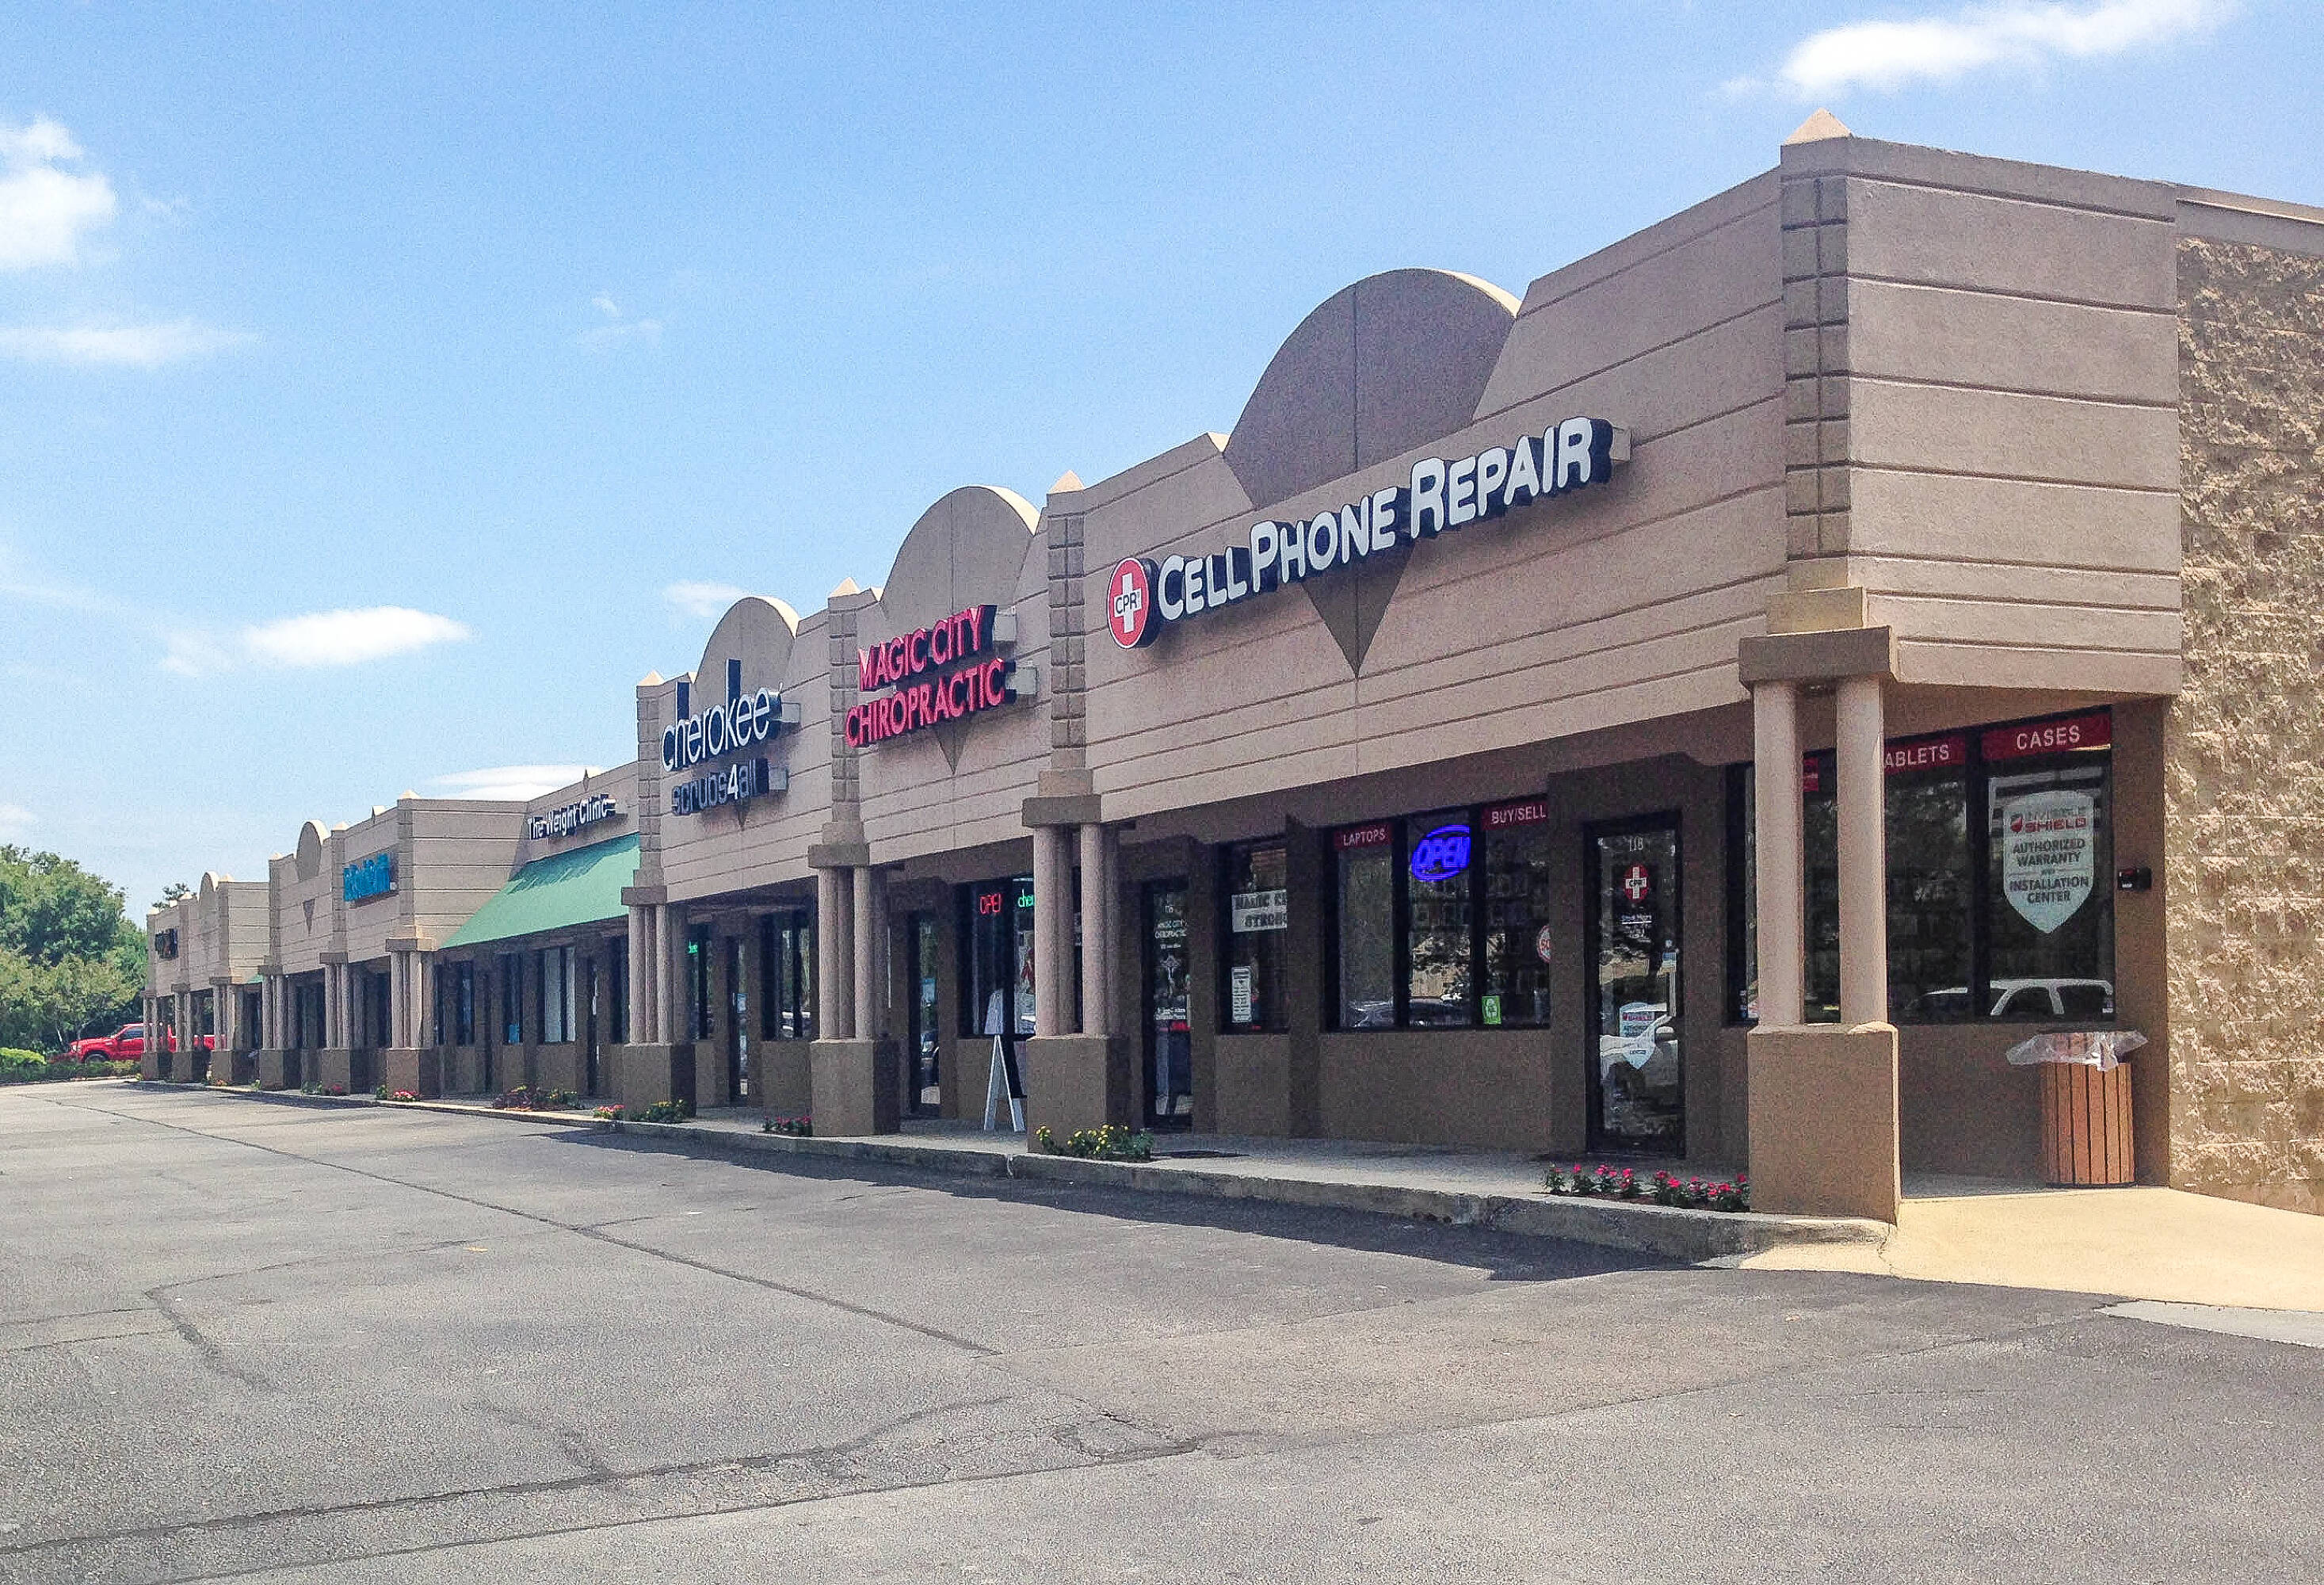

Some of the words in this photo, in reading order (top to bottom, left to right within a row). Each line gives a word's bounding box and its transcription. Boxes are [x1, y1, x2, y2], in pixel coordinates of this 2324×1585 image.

[1158, 547, 1248, 621] CELL
[1250, 486, 1398, 593] PHONE
[1410, 415, 1593, 539] REPAIR
[1115, 591, 1138, 614] CPR
[859, 628, 927, 692] MAGIC
[931, 605, 983, 665] CITY
[845, 658, 1006, 749] CHIROPRACTIC
[662, 659, 770, 772] cherokee
[2016, 724, 2082, 750] CASES
[1883, 744, 1950, 767] ABLETS
[527, 816, 546, 840] The
[546, 804, 577, 836] Weight
[578, 795, 609, 824] Clinic
[1490, 804, 1547, 825] BUY/SELL
[2025, 817, 2087, 833] SHIELD
[1343, 829, 1386, 847] LAPTOPS
[2013, 838, 2085, 854] AUTHORIZED
[1414, 836, 1471, 870] OPEN
[2017, 851, 2082, 867] WARRANTY
[2009, 876, 2090, 892] INSTALLATION
[2027, 890, 2071, 904] CENTER
